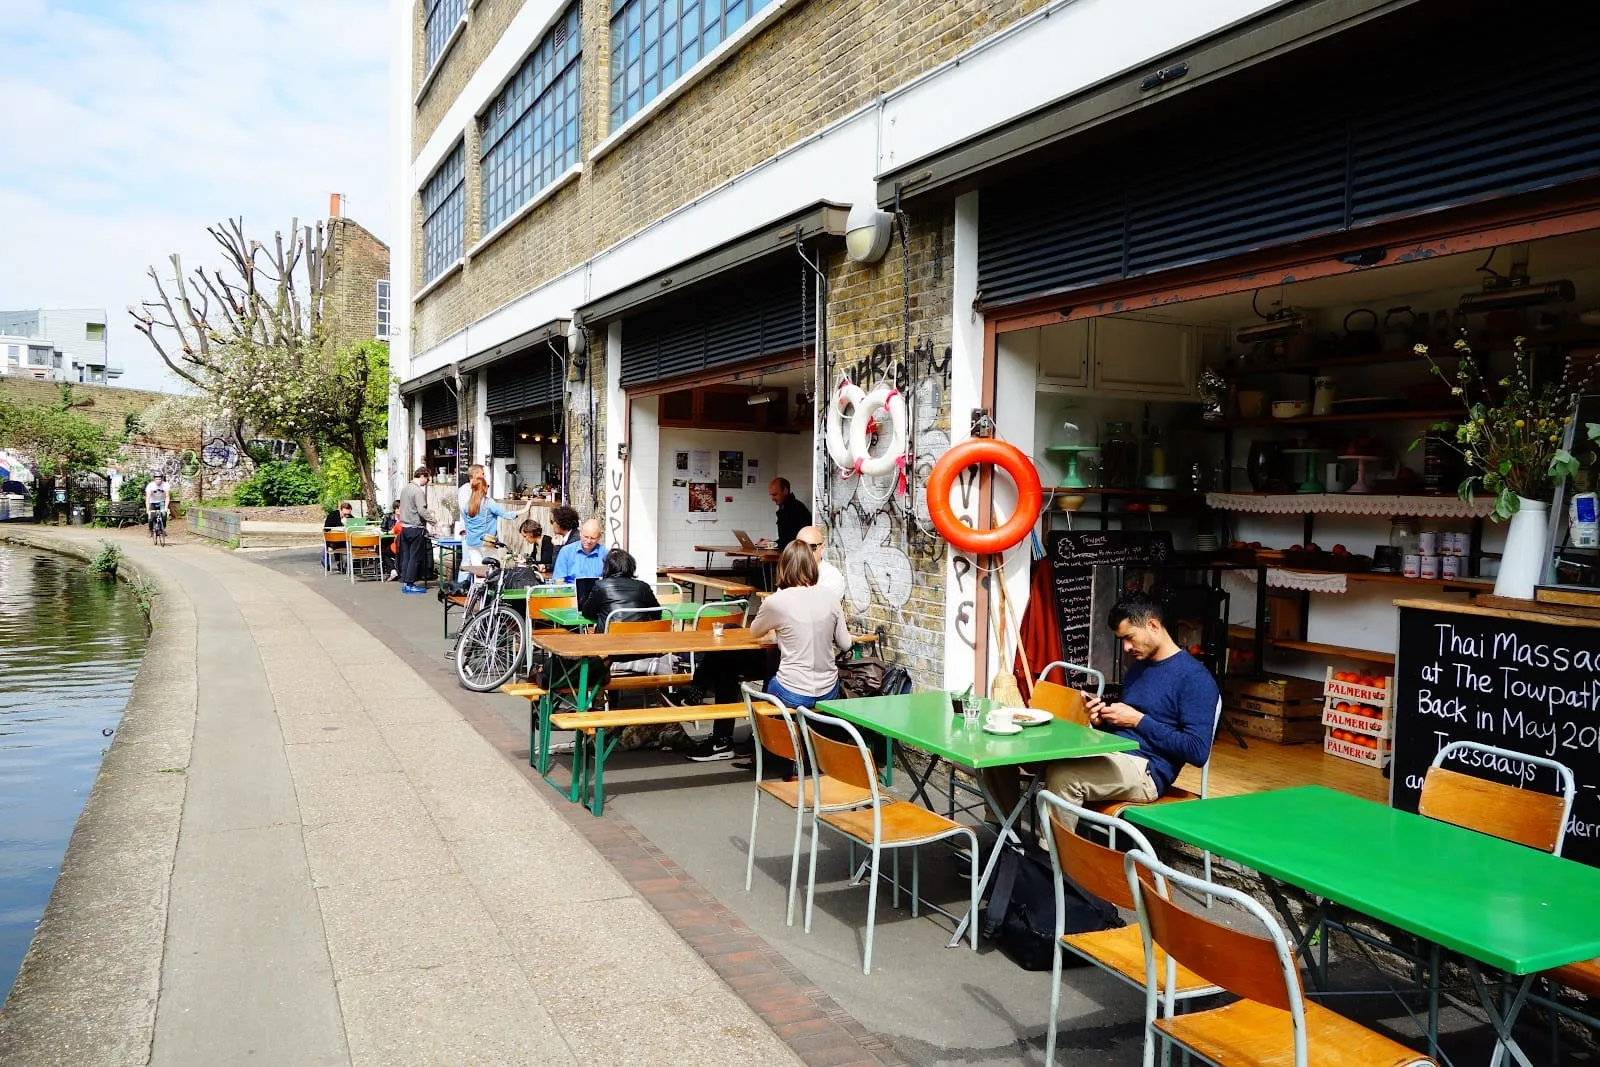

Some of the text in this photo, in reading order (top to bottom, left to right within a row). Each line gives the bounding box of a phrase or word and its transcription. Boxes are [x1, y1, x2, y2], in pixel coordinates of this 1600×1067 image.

[1434, 624, 1485, 658] Thai
[1328, 683, 1371, 700] PALMERI
[1421, 661, 1600, 715] at The Towpath
[1326, 713, 1368, 731] PALMERI
[1418, 689, 1468, 723] Back
[1476, 704, 1494, 732] in
[1327, 741, 1364, 758] PALMERI
